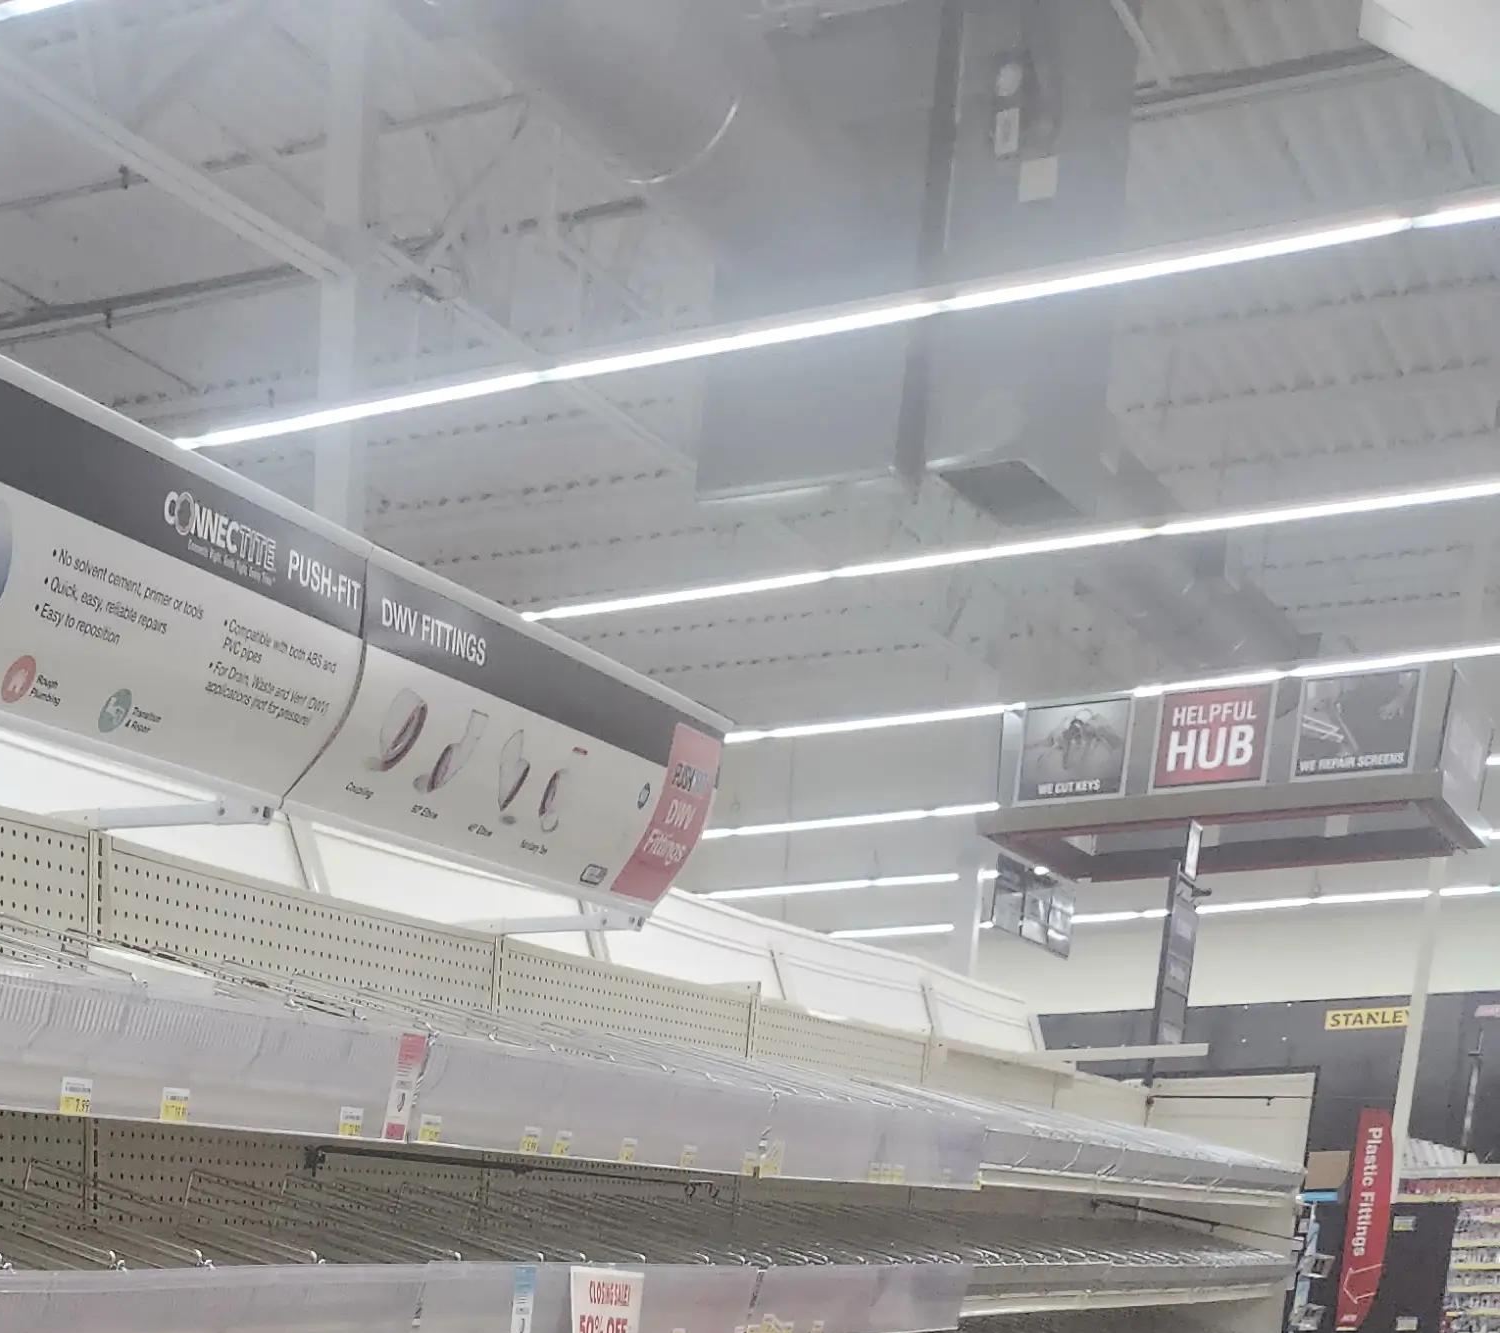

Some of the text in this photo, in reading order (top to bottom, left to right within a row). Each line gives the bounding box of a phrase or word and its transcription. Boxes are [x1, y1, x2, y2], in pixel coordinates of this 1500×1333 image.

[59, 549, 73, 567] No
[74, 557, 108, 581] solvent
[108, 571, 141, 598] cement,
[143, 586, 172, 608] primer
[184, 600, 204, 621] tools
[287, 549, 362, 610] PUSH-FIT
[41, 603, 121, 645] Easy to reposition
[50, 576, 167, 635] Quick, easy, reliable repairs
[222, 636, 262, 665] PVC pipes
[382, 598, 487, 668] DWV FITTINGS
[1172, 700, 1257, 727] HELPFUL
[1166, 724, 1255, 773] HUB
[665, 799, 698, 830] DWV
[1352, 1126, 1384, 1257] Plastic Fittings
[589, 1280, 614, 1306] CLOSING
